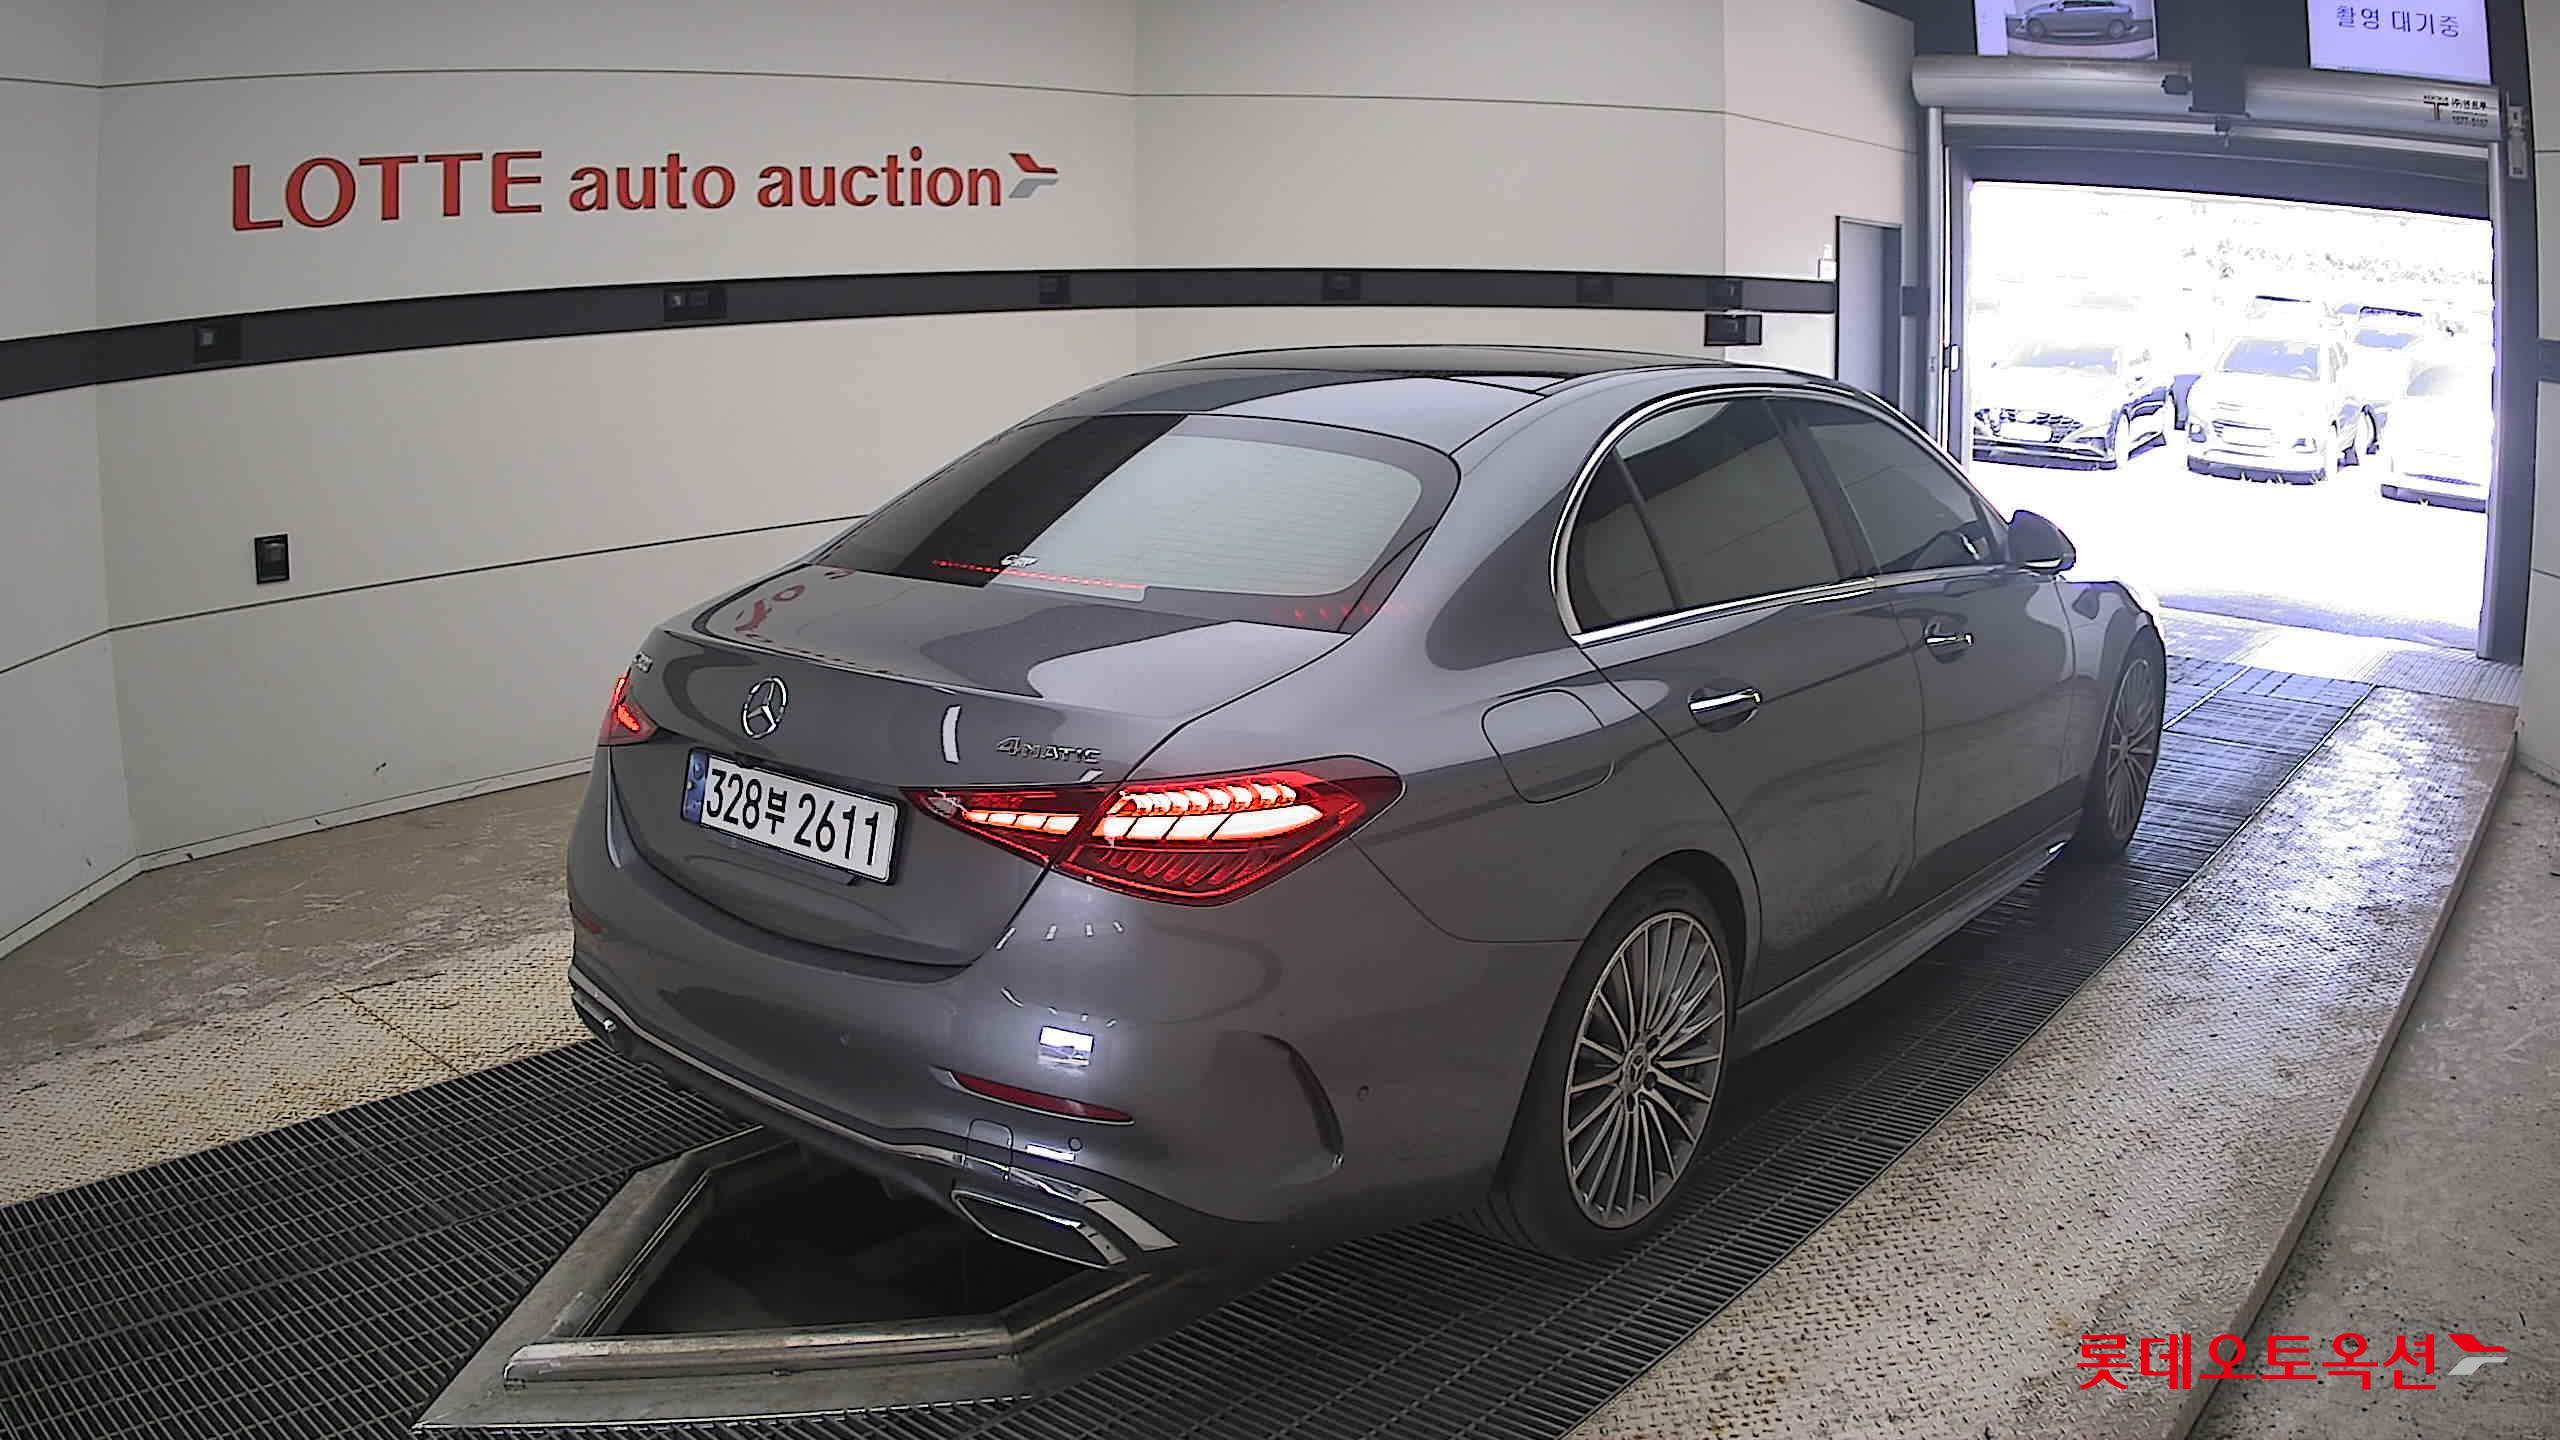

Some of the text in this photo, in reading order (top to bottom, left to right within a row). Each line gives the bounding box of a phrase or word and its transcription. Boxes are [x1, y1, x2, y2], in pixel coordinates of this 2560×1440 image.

[2336, 6, 2459, 38] 촬영 대기중
[232, 146, 1001, 232] LOTTE auto auction
[996, 735, 1102, 765] 4MATIC
[706, 768, 880, 866] 328부 2611
